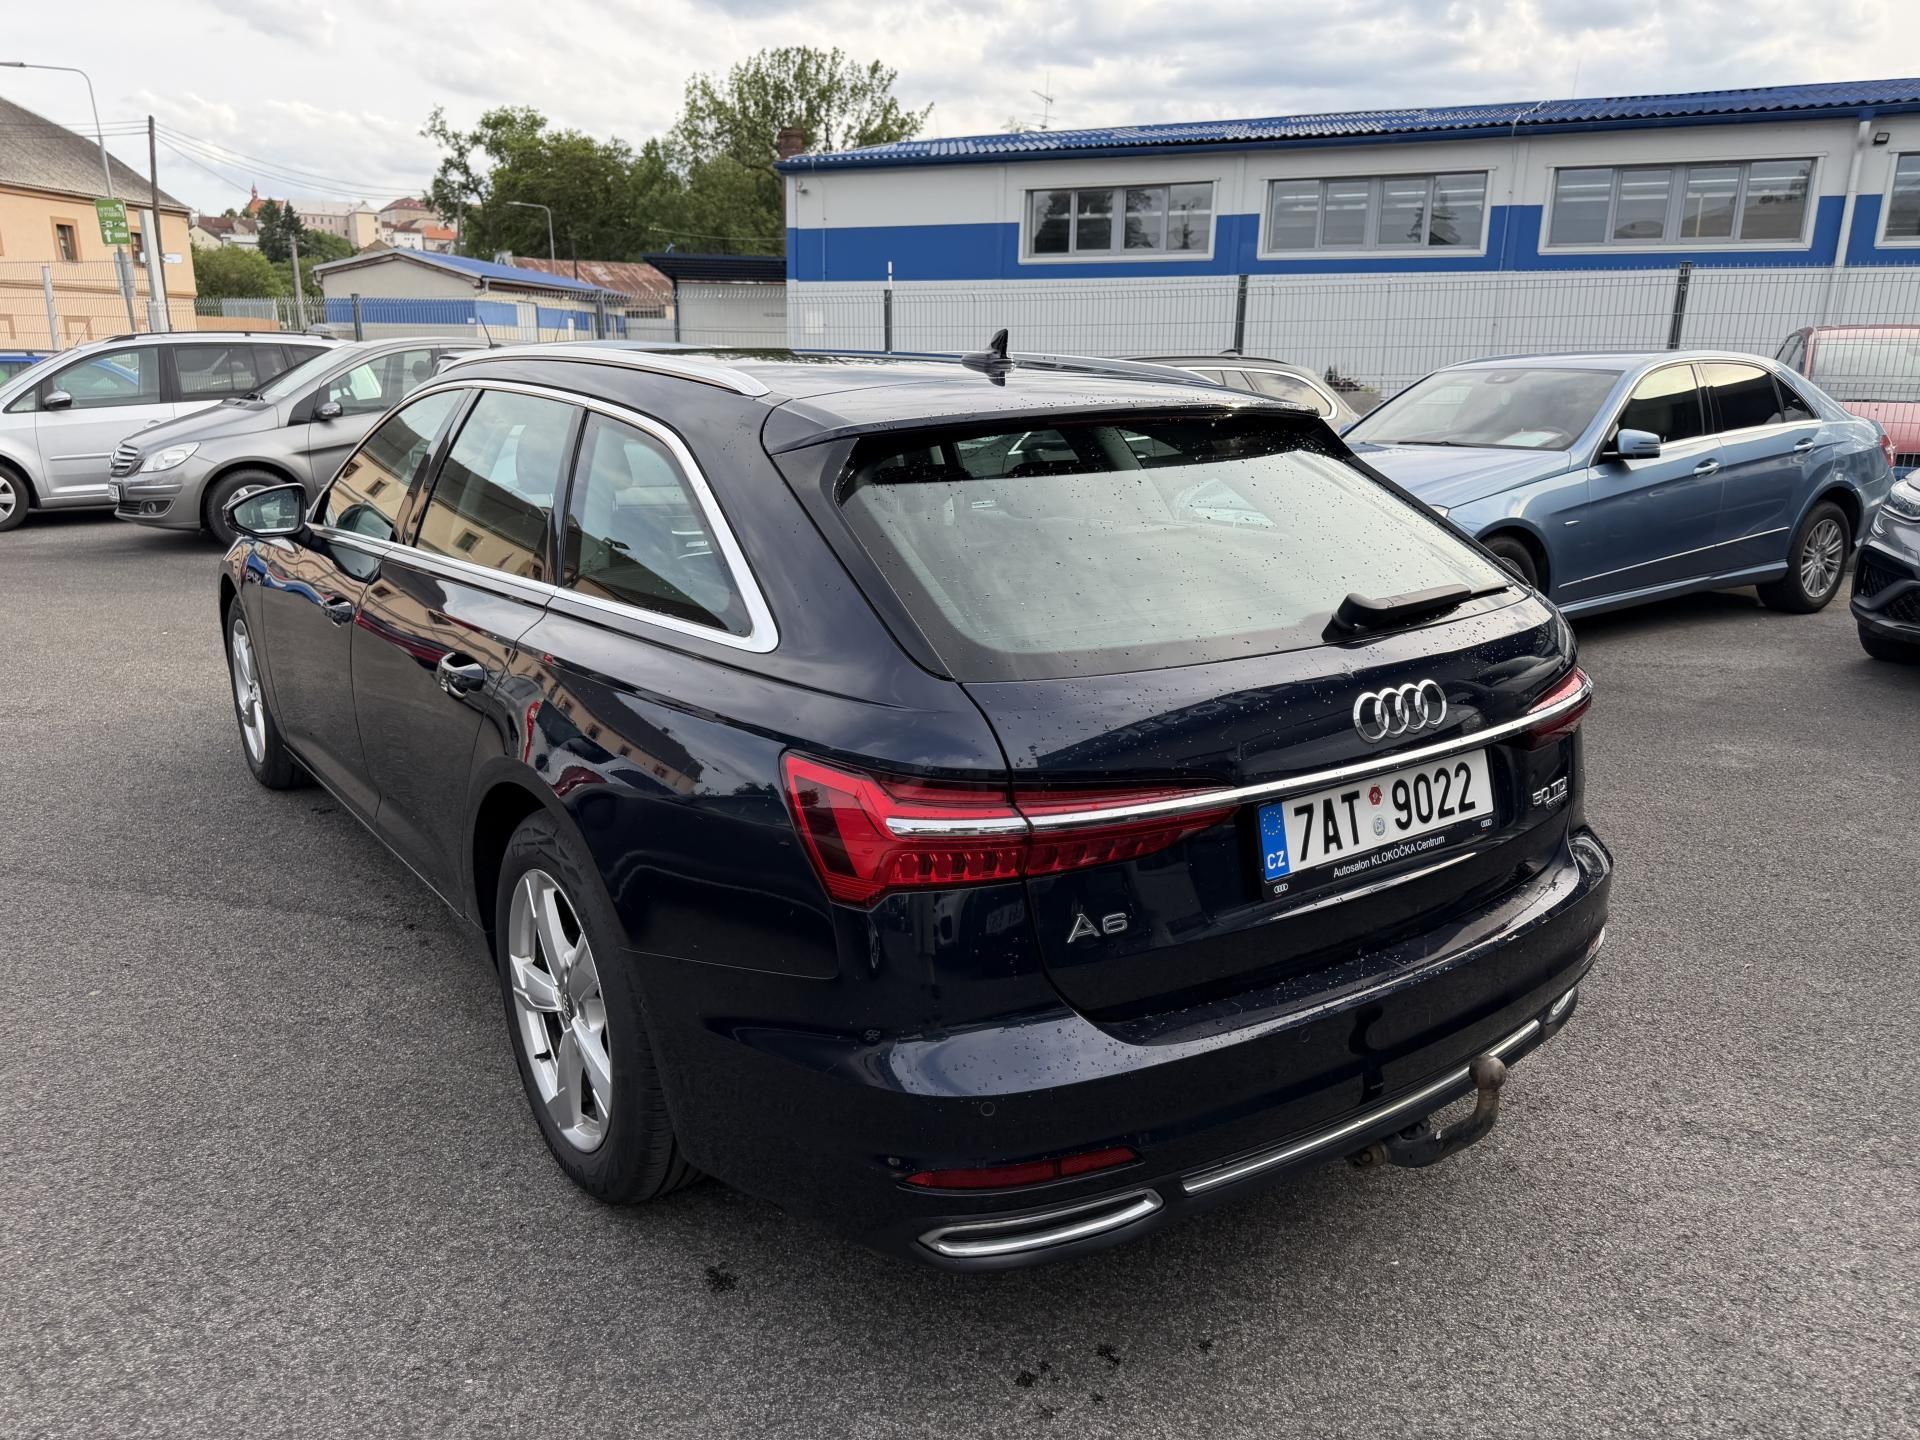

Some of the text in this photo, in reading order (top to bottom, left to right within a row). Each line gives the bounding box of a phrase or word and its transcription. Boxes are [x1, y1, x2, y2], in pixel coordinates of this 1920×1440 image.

[1531, 786, 1550, 804] 50
[1549, 775, 1568, 797] TDI
[1293, 761, 1476, 862] 7AT 9022
[1266, 849, 1286, 870] CZ
[1333, 835, 1445, 879] Autosalon KLOKOČKA Centrum
[1066, 912, 1129, 944] A6
